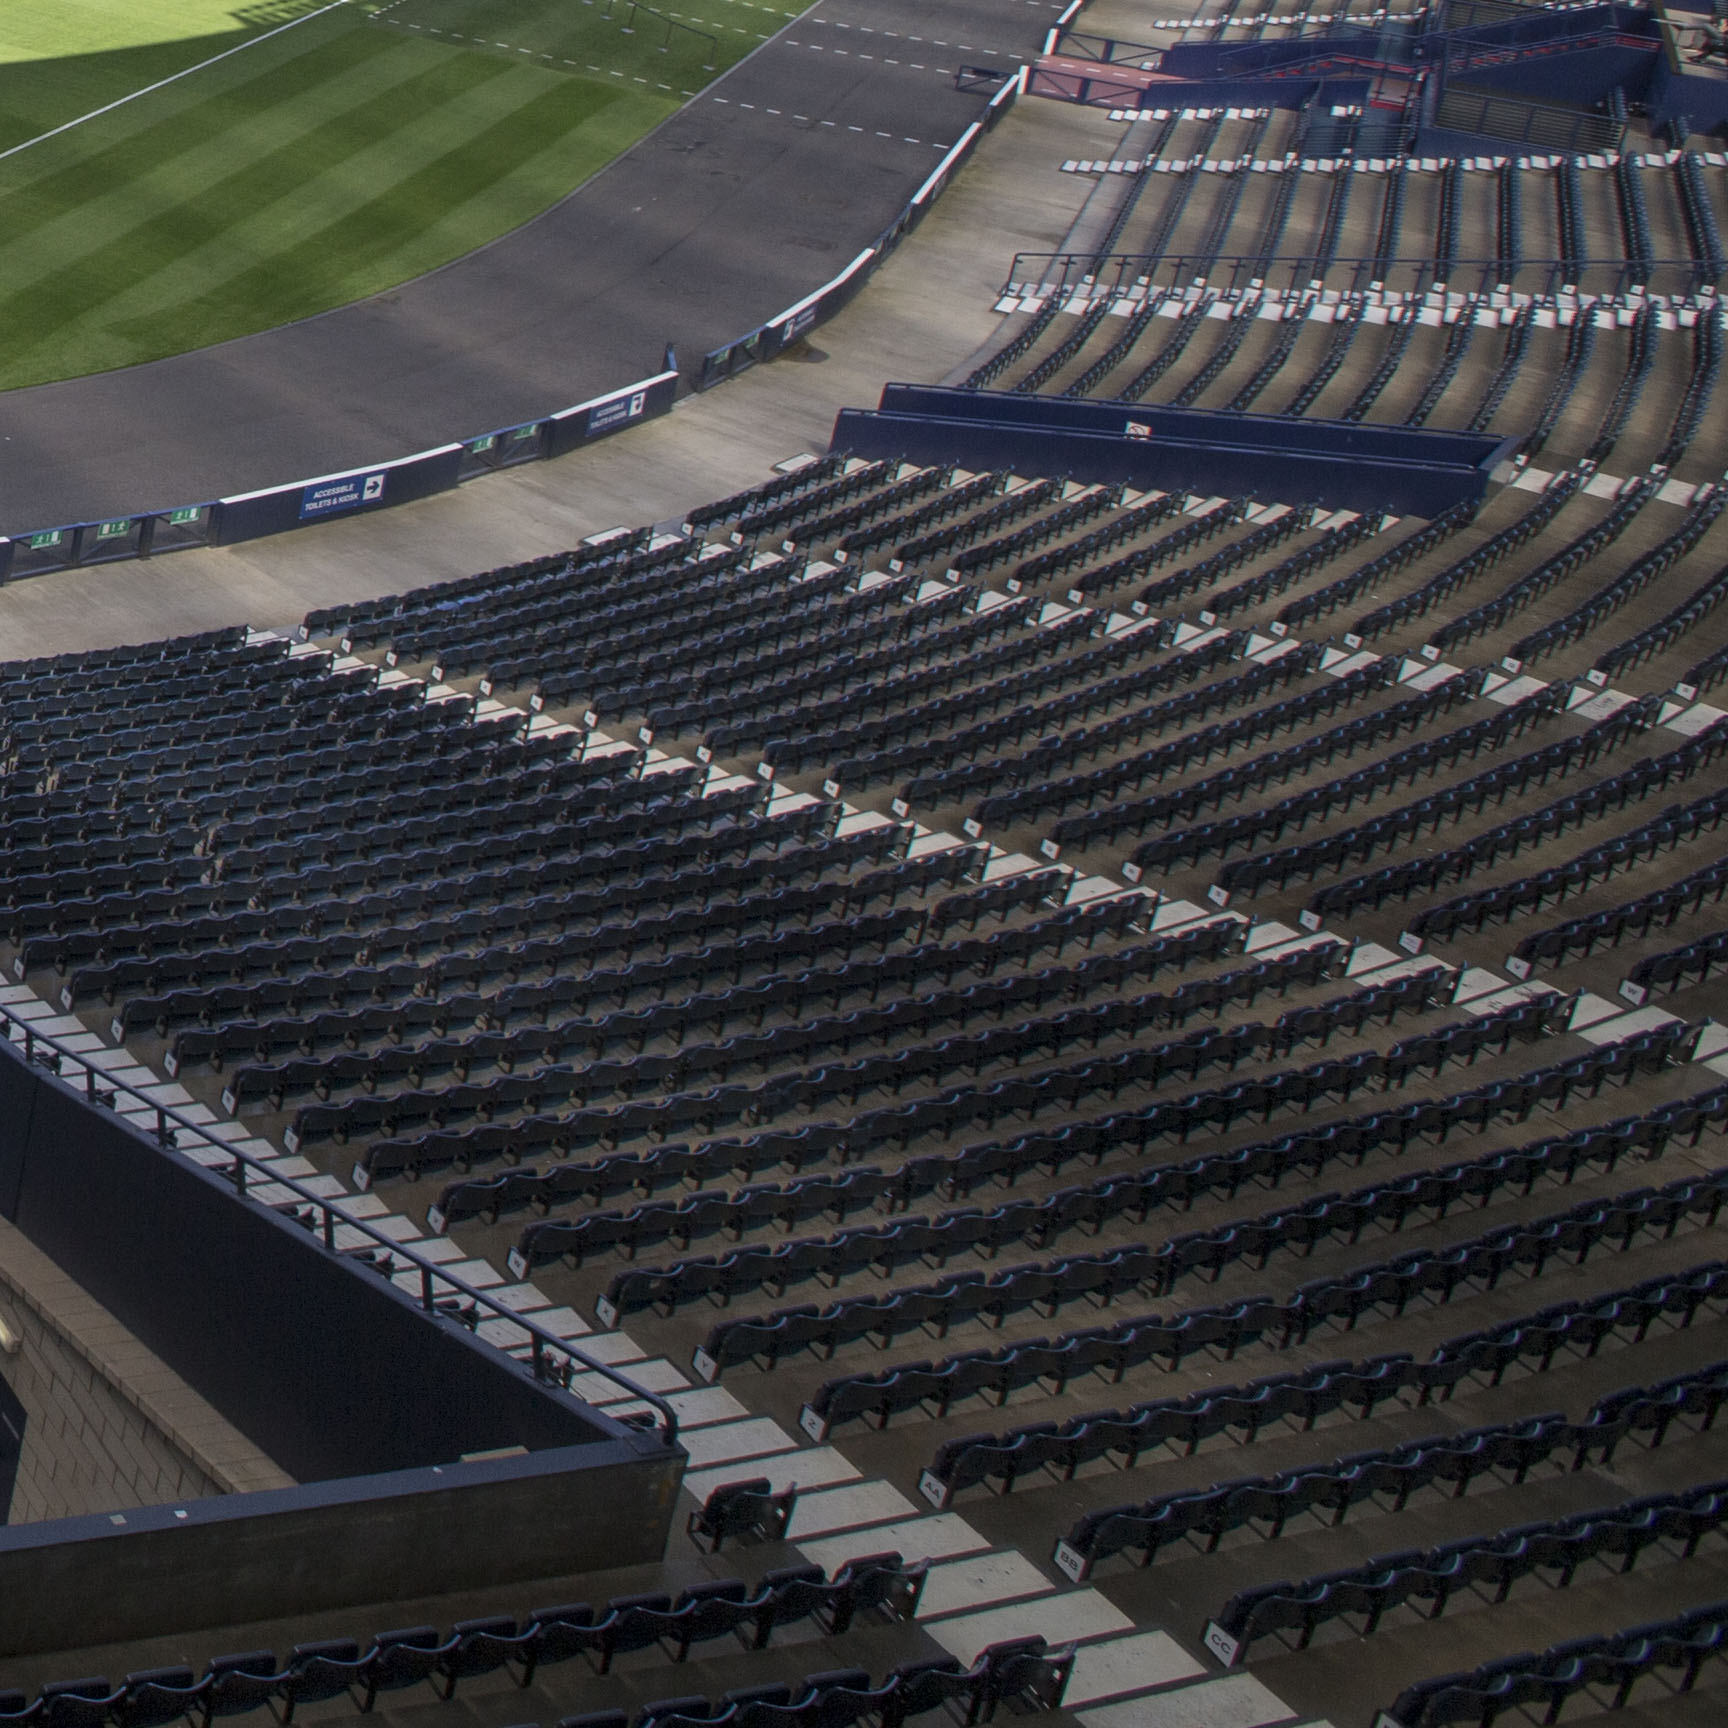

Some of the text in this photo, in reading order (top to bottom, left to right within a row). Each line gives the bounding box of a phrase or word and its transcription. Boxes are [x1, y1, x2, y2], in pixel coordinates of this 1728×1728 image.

[314, 483, 354, 499] ACCESSIBLE
[305, 493, 359, 511] TOILETS & KIOSK
[1625, 985, 1638, 997] W
[924, 1479, 942, 1500] AA
[1060, 1550, 1080, 1572] BB
[1210, 1632, 1232, 1656] CC
